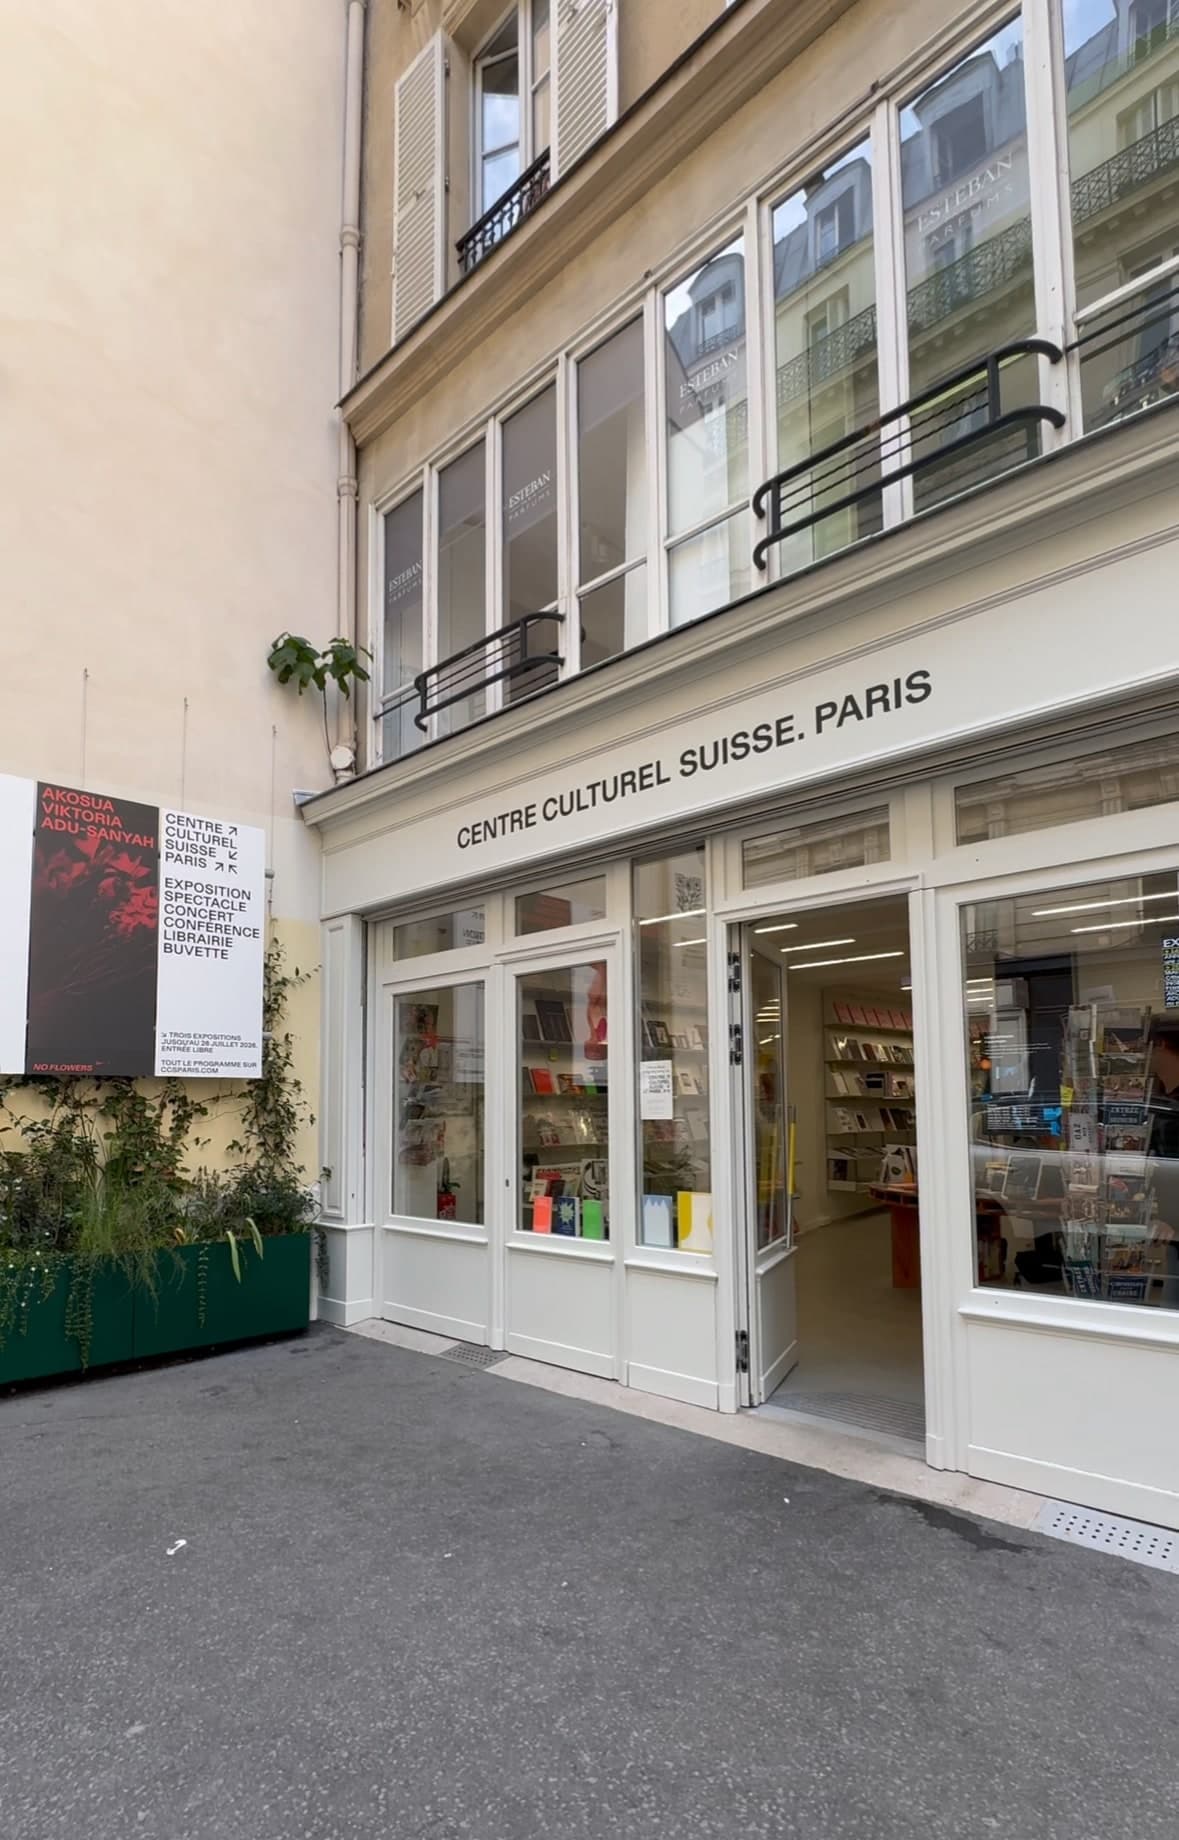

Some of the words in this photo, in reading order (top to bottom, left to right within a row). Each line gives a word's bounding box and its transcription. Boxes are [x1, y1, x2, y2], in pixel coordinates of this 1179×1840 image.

[919, 151, 1012, 233] ESTEBAN
[680, 347, 738, 398] ESTEBAN
[509, 470, 551, 508] ESTEBAN
[389, 560, 422, 593] ESTEBAN
[457, 803, 537, 849] CENTRE
[542, 759, 671, 822] CULTUREL
[679, 714, 805, 777] SUISSE.
[815, 669, 932, 735] PARIS
[42, 787, 114, 813] AKOSUA
[42, 801, 122, 828] VIKTORIA
[165, 813, 223, 834] CENTRE
[41, 816, 154, 848] ADU-SANYAH
[165, 826, 238, 849] CULTUREL
[165, 838, 217, 858] SUISSE
[164, 851, 207, 869] PARIS
[164, 877, 251, 901] EXPOSITION
[164, 890, 247, 912] SPECTACLE
[164, 903, 235, 922] CONCERT
[163, 929, 233, 948] LIBRAIRIE
[163, 942, 229, 960] BUVETTE
[161, 1039, 199, 1047] JUSQU'AU
[193, 1033, 241, 1041] EXPOSITIONS
[33, 1063, 48, 1071] NO
[48, 1063, 94, 1072] FLOWERS
[193, 1060, 241, 1068] PROGRAMME
